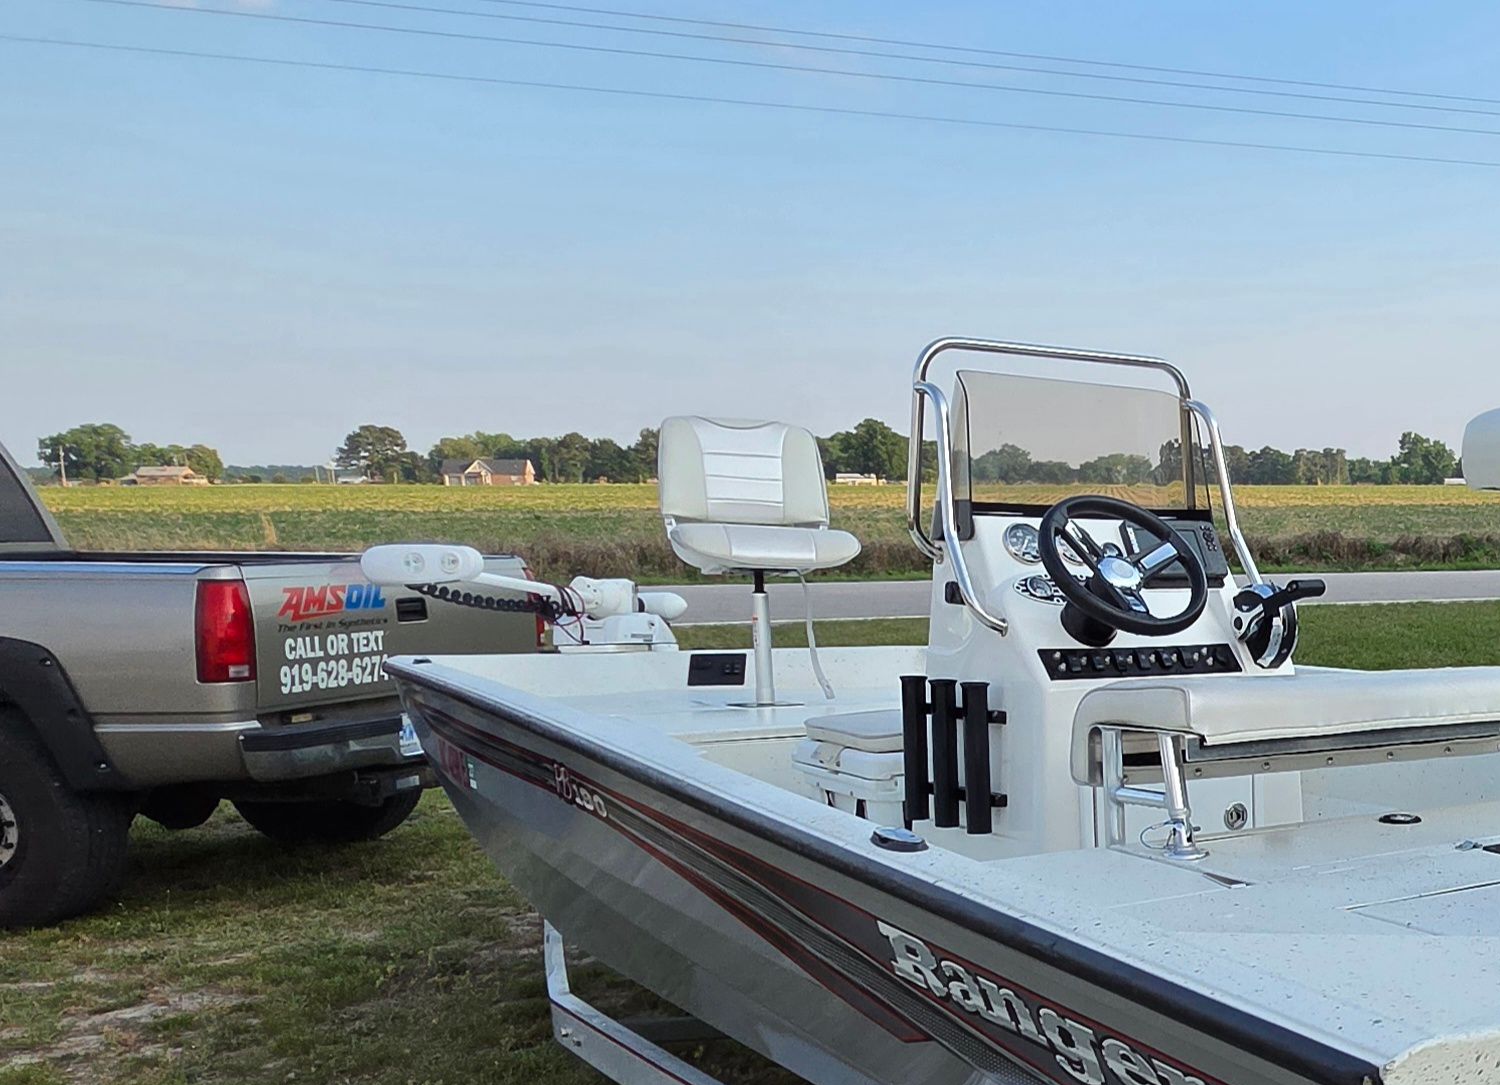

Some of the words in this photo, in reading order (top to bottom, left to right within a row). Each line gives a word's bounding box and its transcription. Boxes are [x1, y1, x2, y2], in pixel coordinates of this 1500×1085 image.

[278, 584, 386, 622] AMSOIL
[284, 636, 324, 660] CALL
[326, 633, 349, 656] OR
[350, 630, 384, 653] TEXT
